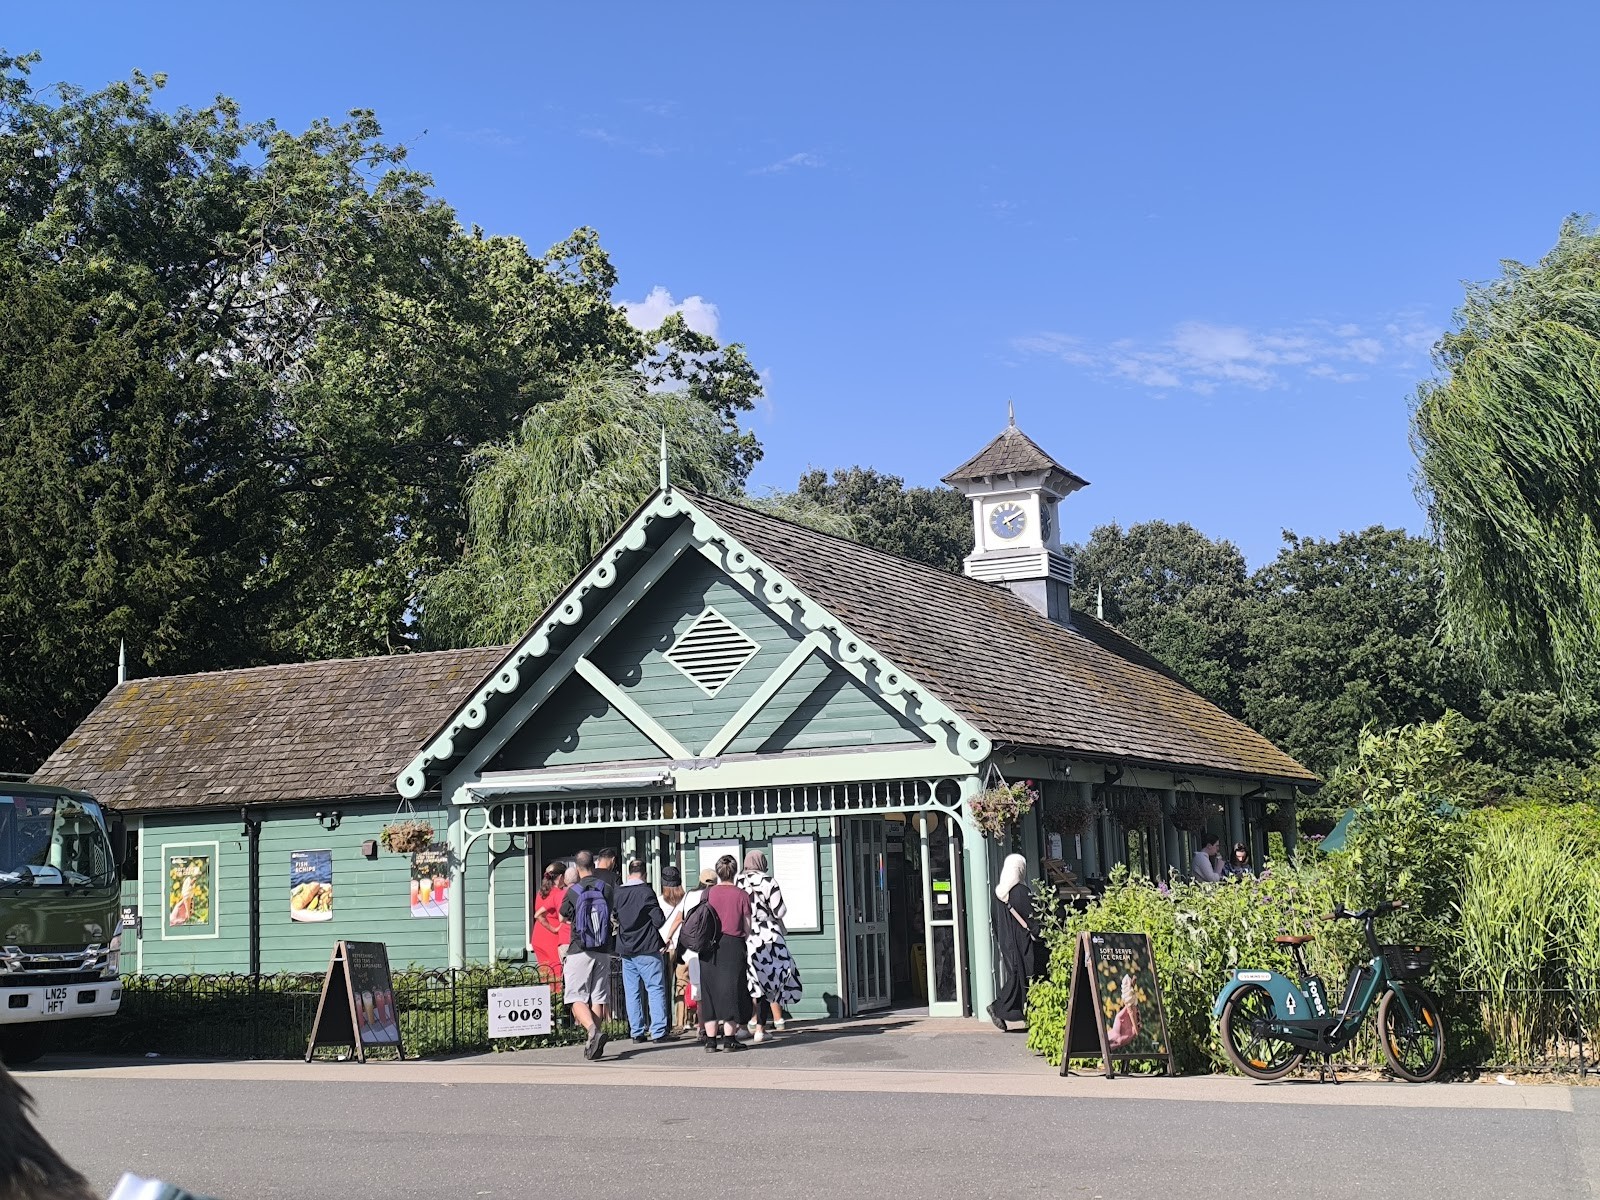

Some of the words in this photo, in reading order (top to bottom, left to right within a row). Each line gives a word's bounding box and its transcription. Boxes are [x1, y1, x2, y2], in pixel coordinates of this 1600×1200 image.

[45, 987, 67, 1000] LN25
[1308, 980, 1327, 1017] forest
[47, 1000, 64, 1013] HFT
[497, 997, 543, 1008] TOILETS
